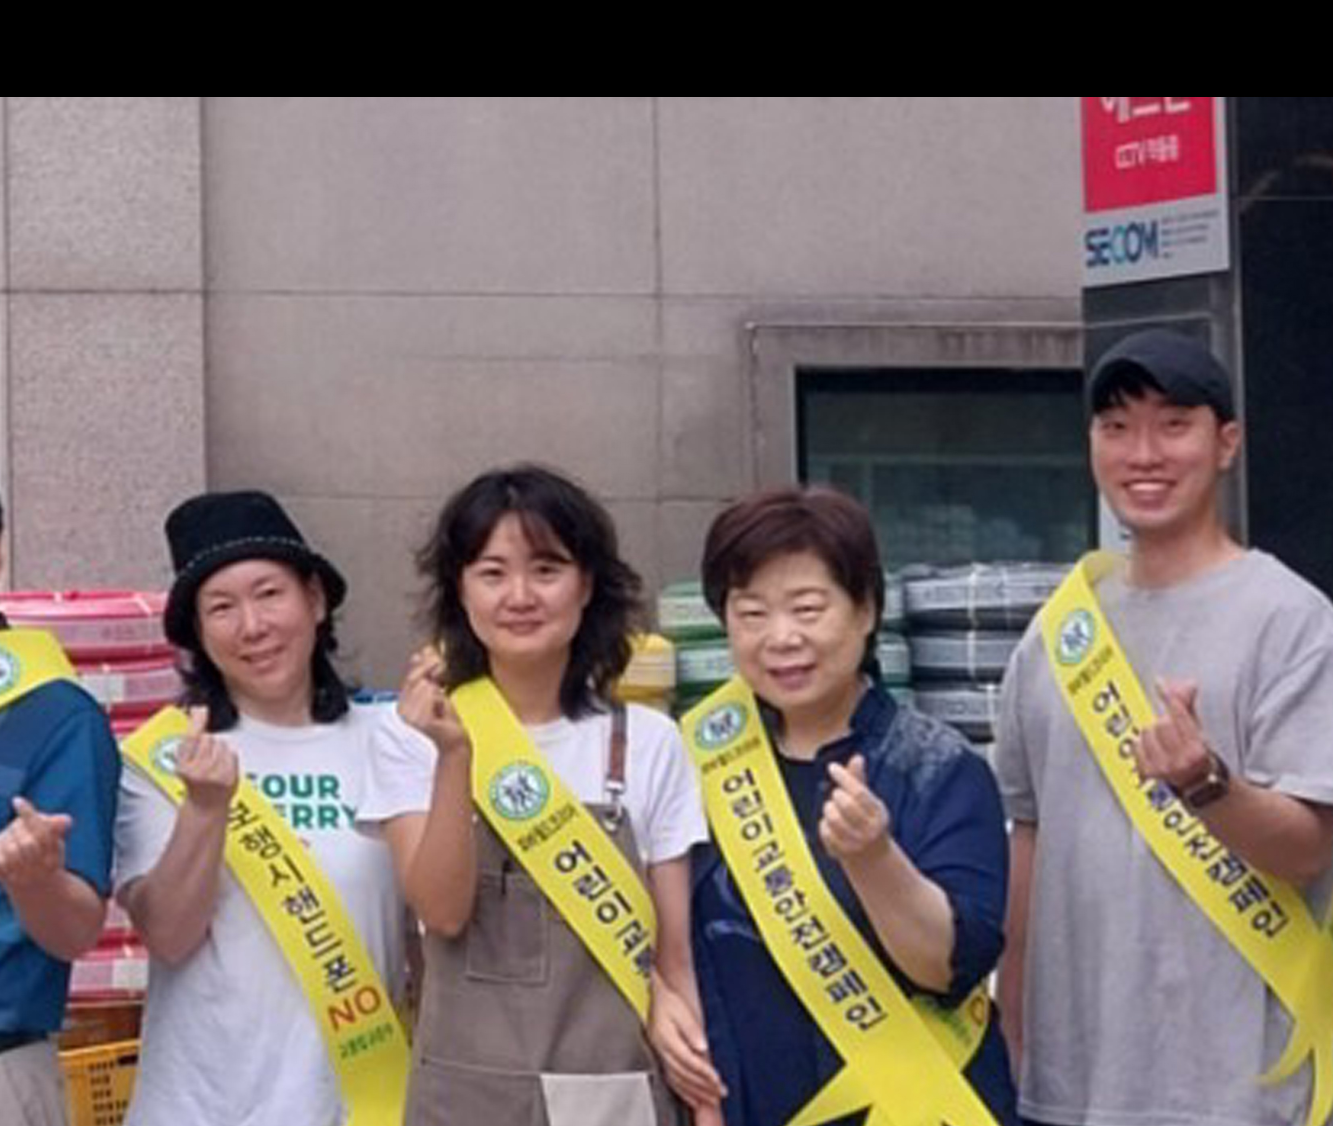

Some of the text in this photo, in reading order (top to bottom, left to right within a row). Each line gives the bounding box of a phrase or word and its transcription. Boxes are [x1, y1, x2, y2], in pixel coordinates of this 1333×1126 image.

[1084, 219, 1158, 267] SECOM
[247, 772, 340, 799] OUR
[327, 985, 382, 1032] NO
